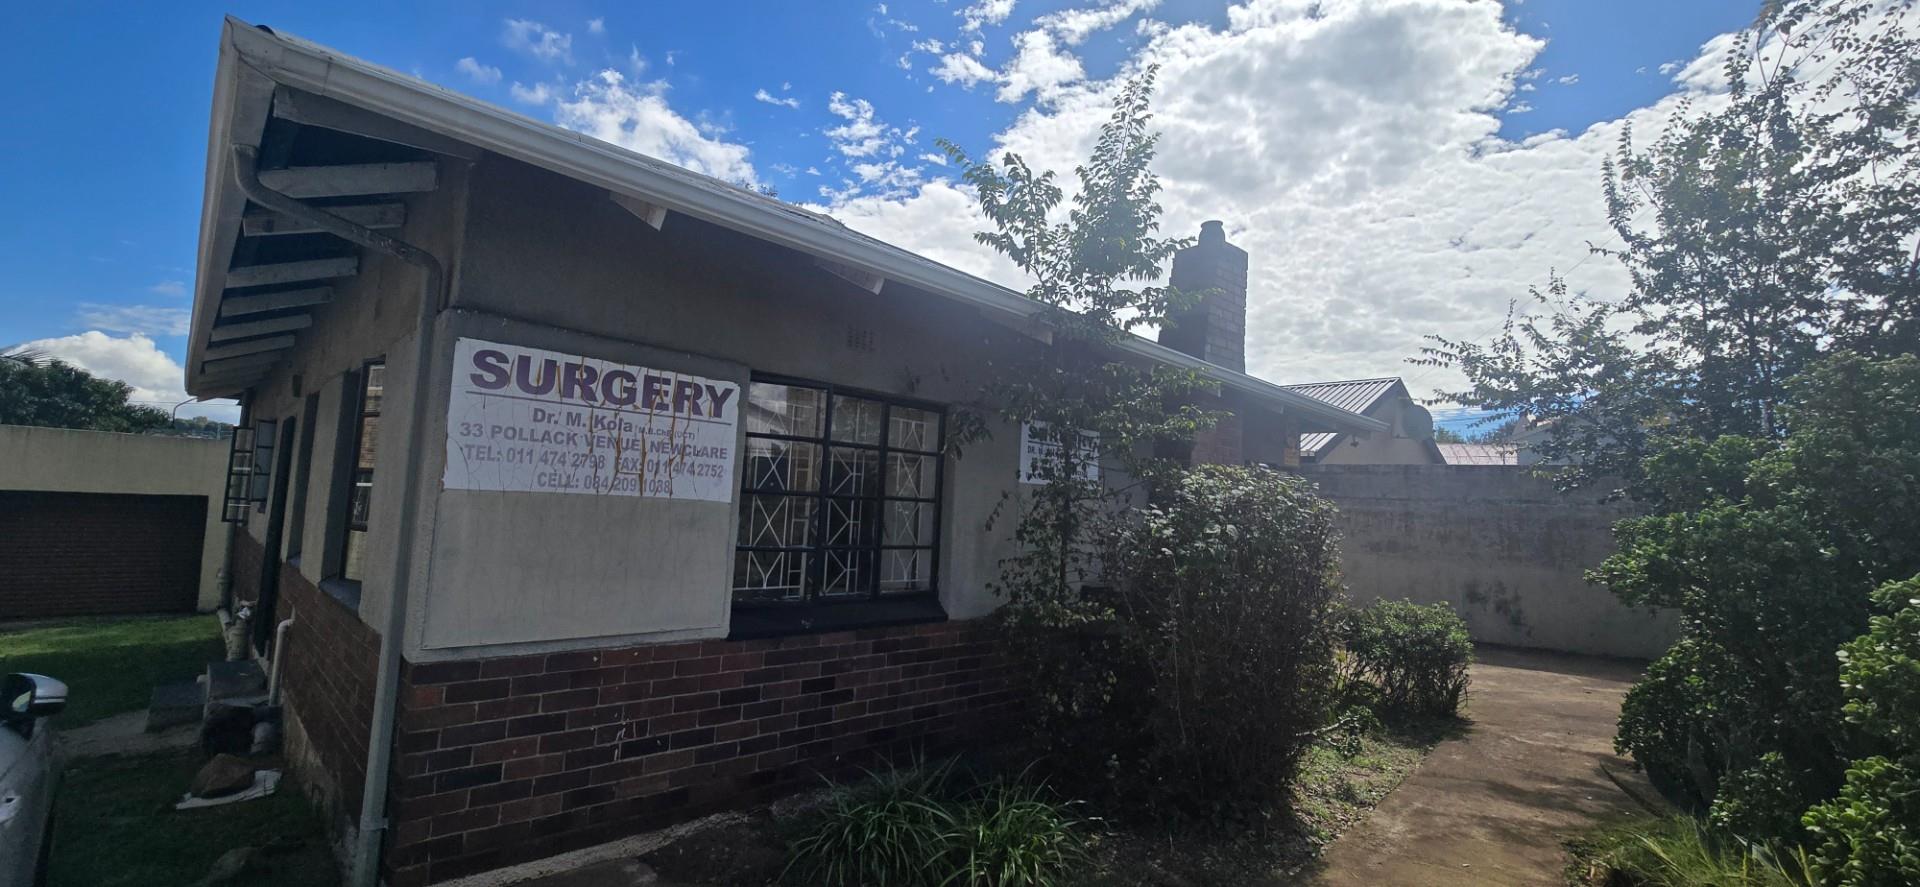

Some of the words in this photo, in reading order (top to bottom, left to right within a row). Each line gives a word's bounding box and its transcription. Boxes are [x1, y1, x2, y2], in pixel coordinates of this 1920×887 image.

[470, 349, 733, 418] SURGERY
[533, 407, 558, 424] Dr.
[566, 411, 587, 427] M.
[593, 414, 633, 432] Kola
[460, 422, 483, 437] 33
[491, 424, 577, 446] POLLACK
[650, 440, 728, 459] NEWCLARE
[464, 444, 500, 461] TEL:
[506, 447, 533, 464] 011
[540, 450, 567, 467] 474
[571, 452, 605, 470] 2798
[647, 459, 669, 474] 011
[673, 462, 694, 476] 474
[697, 463, 724, 478] 2752
[537, 471, 579, 488] CELL:
[614, 477, 637, 492] 209
